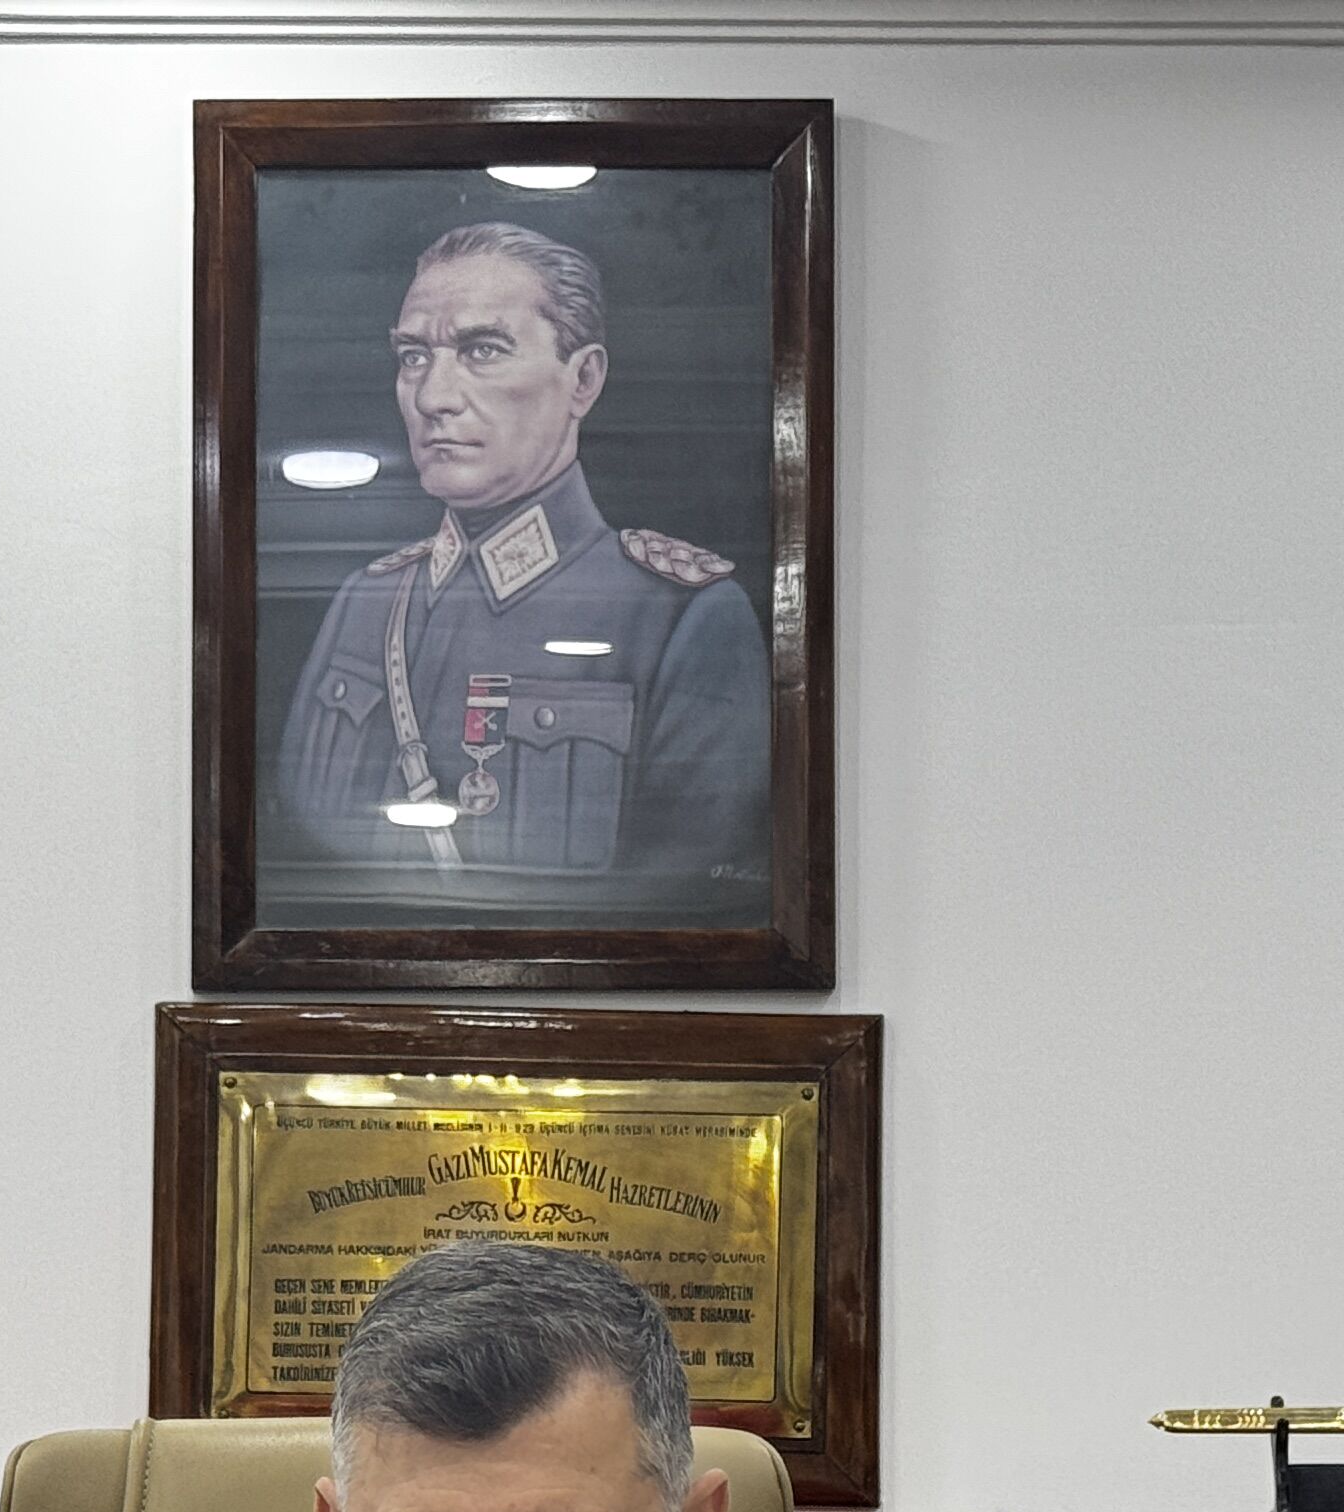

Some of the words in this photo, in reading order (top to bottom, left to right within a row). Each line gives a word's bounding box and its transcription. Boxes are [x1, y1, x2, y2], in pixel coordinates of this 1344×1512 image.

[360, 1118, 391, 1130] BÜYÜK
[547, 1148, 609, 1194] KEMAL
[262, 1243, 333, 1256] JANDARMA
[712, 1252, 766, 1265] OLUNUR
[311, 1279, 336, 1295] SENE
